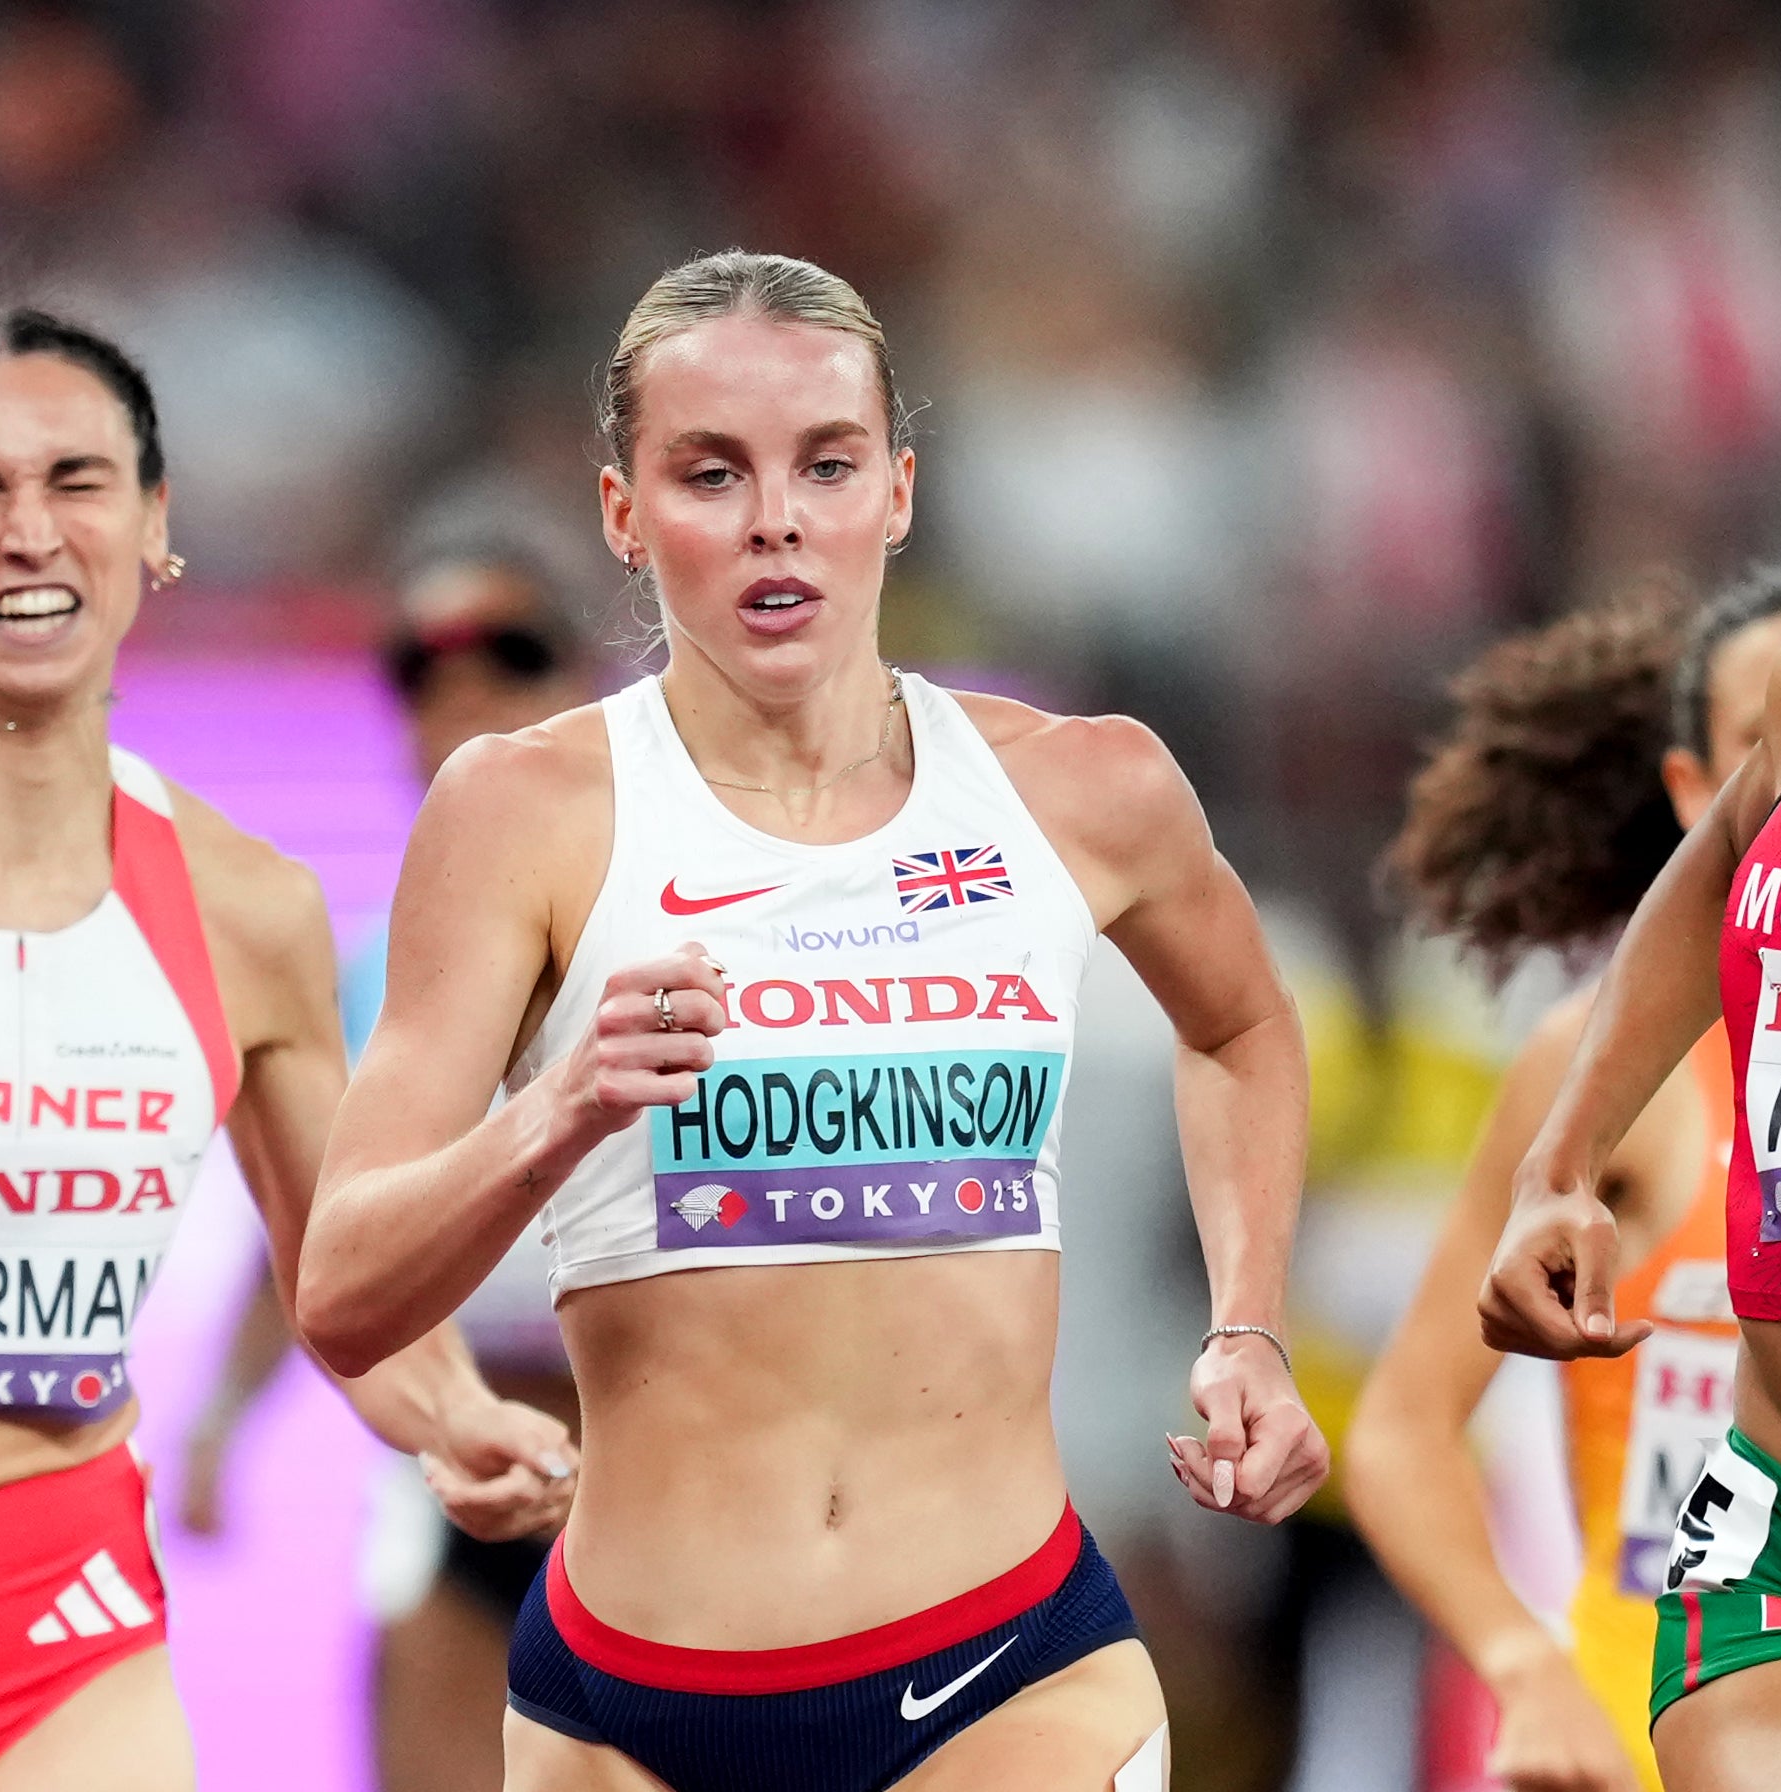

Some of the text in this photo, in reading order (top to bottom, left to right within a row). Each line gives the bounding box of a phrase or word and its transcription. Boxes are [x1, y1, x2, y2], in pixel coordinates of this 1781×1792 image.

[773, 921, 920, 953] Novuna
[723, 974, 1058, 1029] ONDA
[671, 1062, 1049, 1161] HODGKINSON
